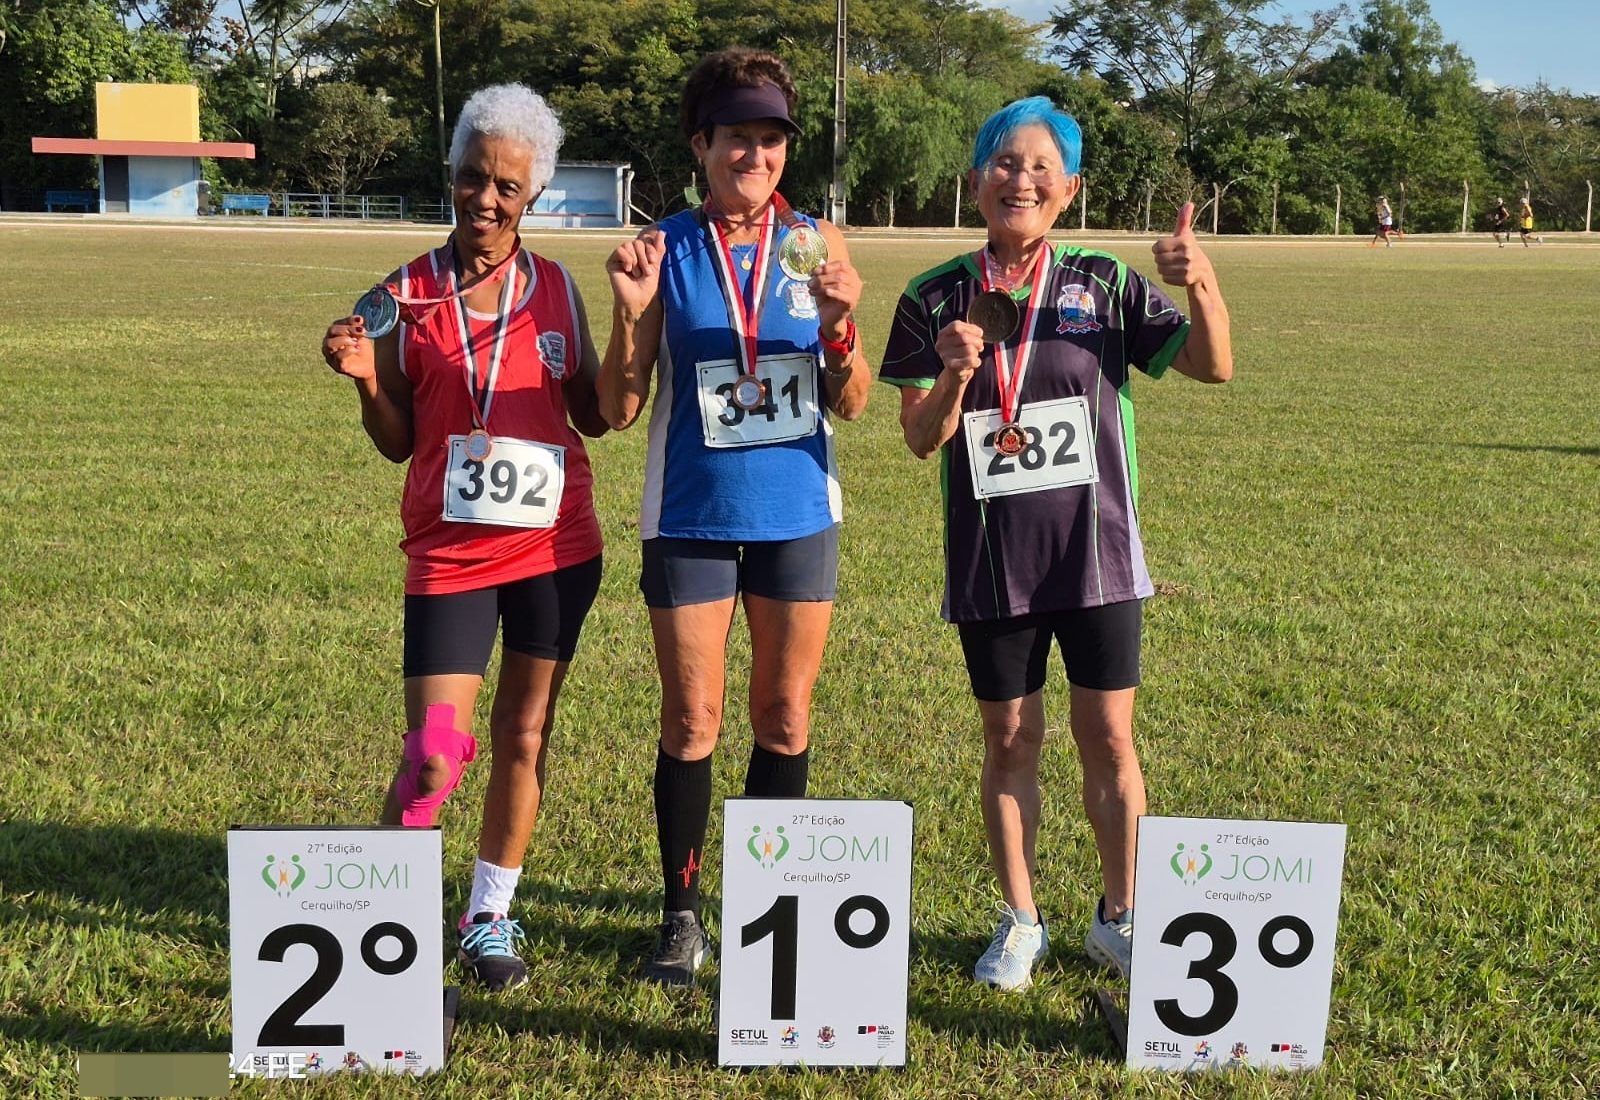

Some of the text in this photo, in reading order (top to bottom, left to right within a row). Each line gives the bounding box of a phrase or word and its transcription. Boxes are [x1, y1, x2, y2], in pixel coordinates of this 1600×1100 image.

[714, 374, 802, 427] 341
[983, 420, 1081, 477] 282
[458, 458, 549, 508] 392
[811, 815, 845, 826] Edição
[1235, 835, 1270, 847] Edição
[327, 843, 363, 855] Edição
[798, 835, 889, 862] JOMI
[1220, 854, 1312, 884] JOMI
[314, 863, 409, 890] JOMI
[783, 872, 851, 884] Cerquilho/SP
[1205, 889, 1273, 902] Cerquilho/SP
[300, 900, 371, 911] Cerquilho/SP
[731, 1029, 769, 1039] SETUL
[1145, 1041, 1181, 1052] SETUL
